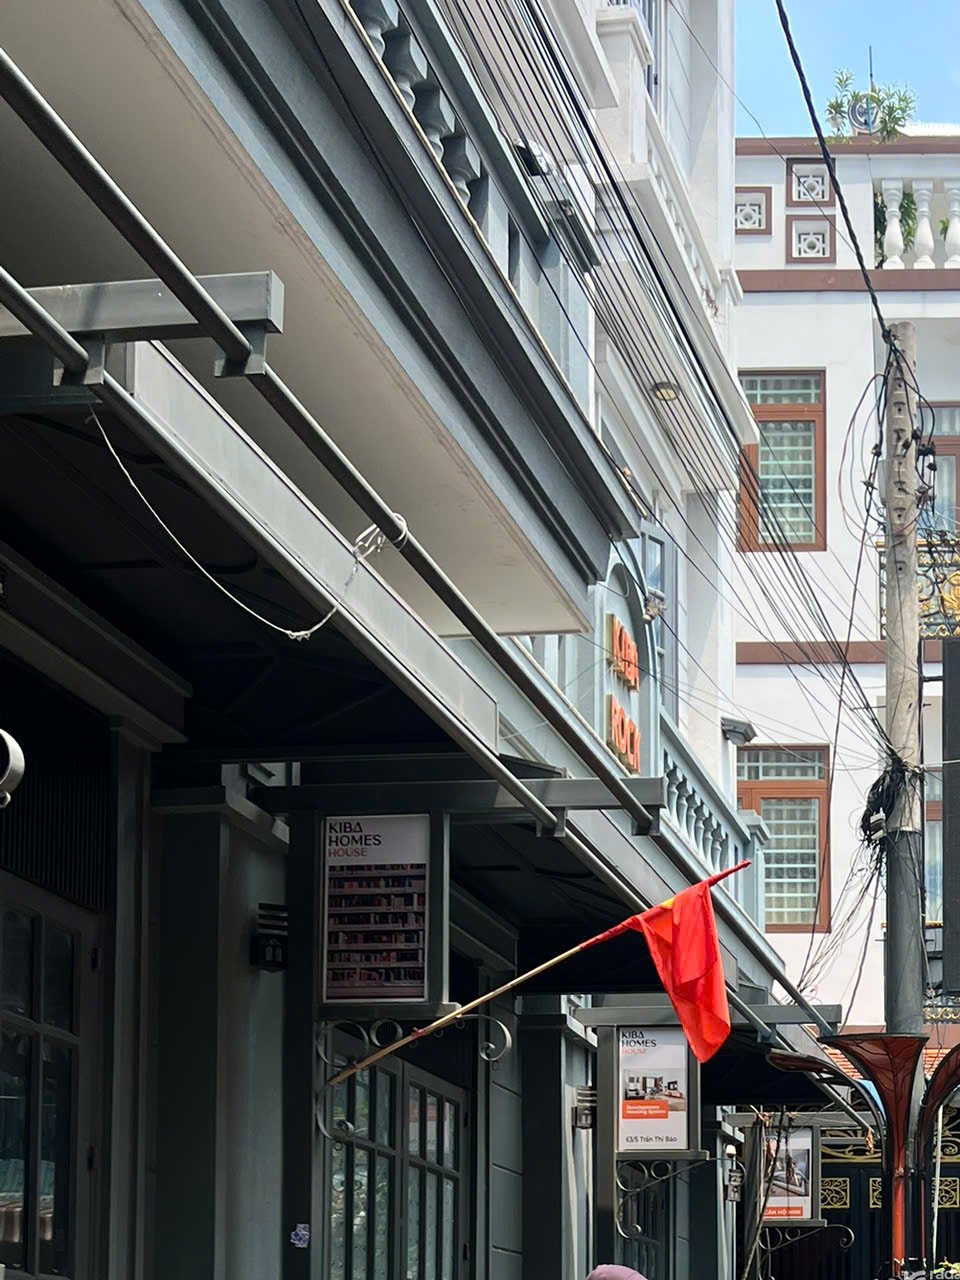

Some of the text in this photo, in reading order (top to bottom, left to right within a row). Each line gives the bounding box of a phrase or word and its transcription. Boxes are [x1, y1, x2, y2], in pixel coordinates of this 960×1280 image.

[611, 614, 641, 692] KIBA
[610, 695, 641, 775] ROCK
[328, 821, 363, 834] KIBA
[328, 834, 382, 847] HOMES
[328, 847, 368, 858] HOUSE
[621, 1030, 645, 1039] KIBA
[621, 1039, 657, 1048] HOMES
